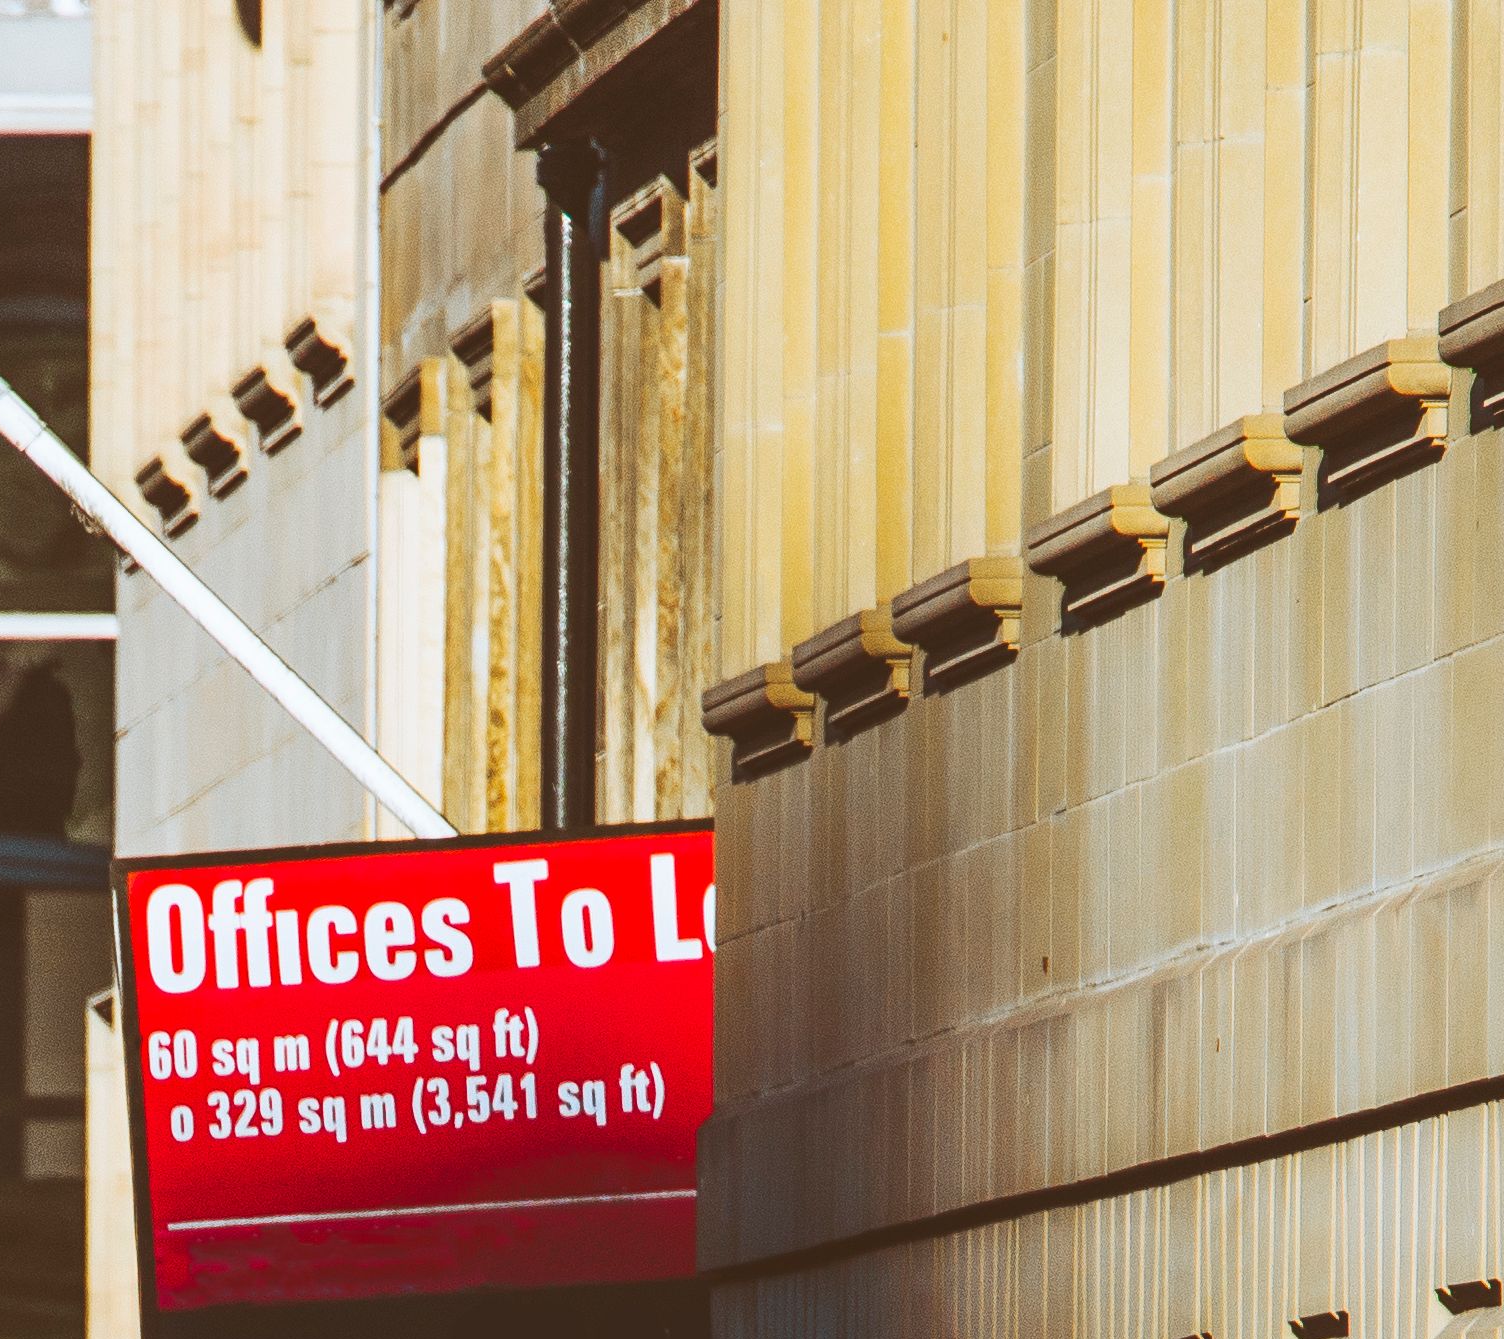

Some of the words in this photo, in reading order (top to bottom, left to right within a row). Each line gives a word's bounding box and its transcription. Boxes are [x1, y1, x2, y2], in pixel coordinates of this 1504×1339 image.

[145, 876, 474, 994] Offices
[492, 857, 615, 969] To
[648, 851, 715, 962] L
[147, 1028, 198, 1081] 60
[210, 1038, 261, 1085] sq
[273, 1034, 311, 1073] m
[324, 1015, 419, 1077] (644
[431, 1024, 481, 1072] sq
[491, 1006, 539, 1064] ft)
[206, 1086, 284, 1139] 329
[297, 1096, 347, 1143] sq
[359, 1092, 397, 1130] m
[410, 1072, 538, 1134] (3,541
[557, 1080, 607, 1126] sq
[618, 1062, 665, 1119] ft)
